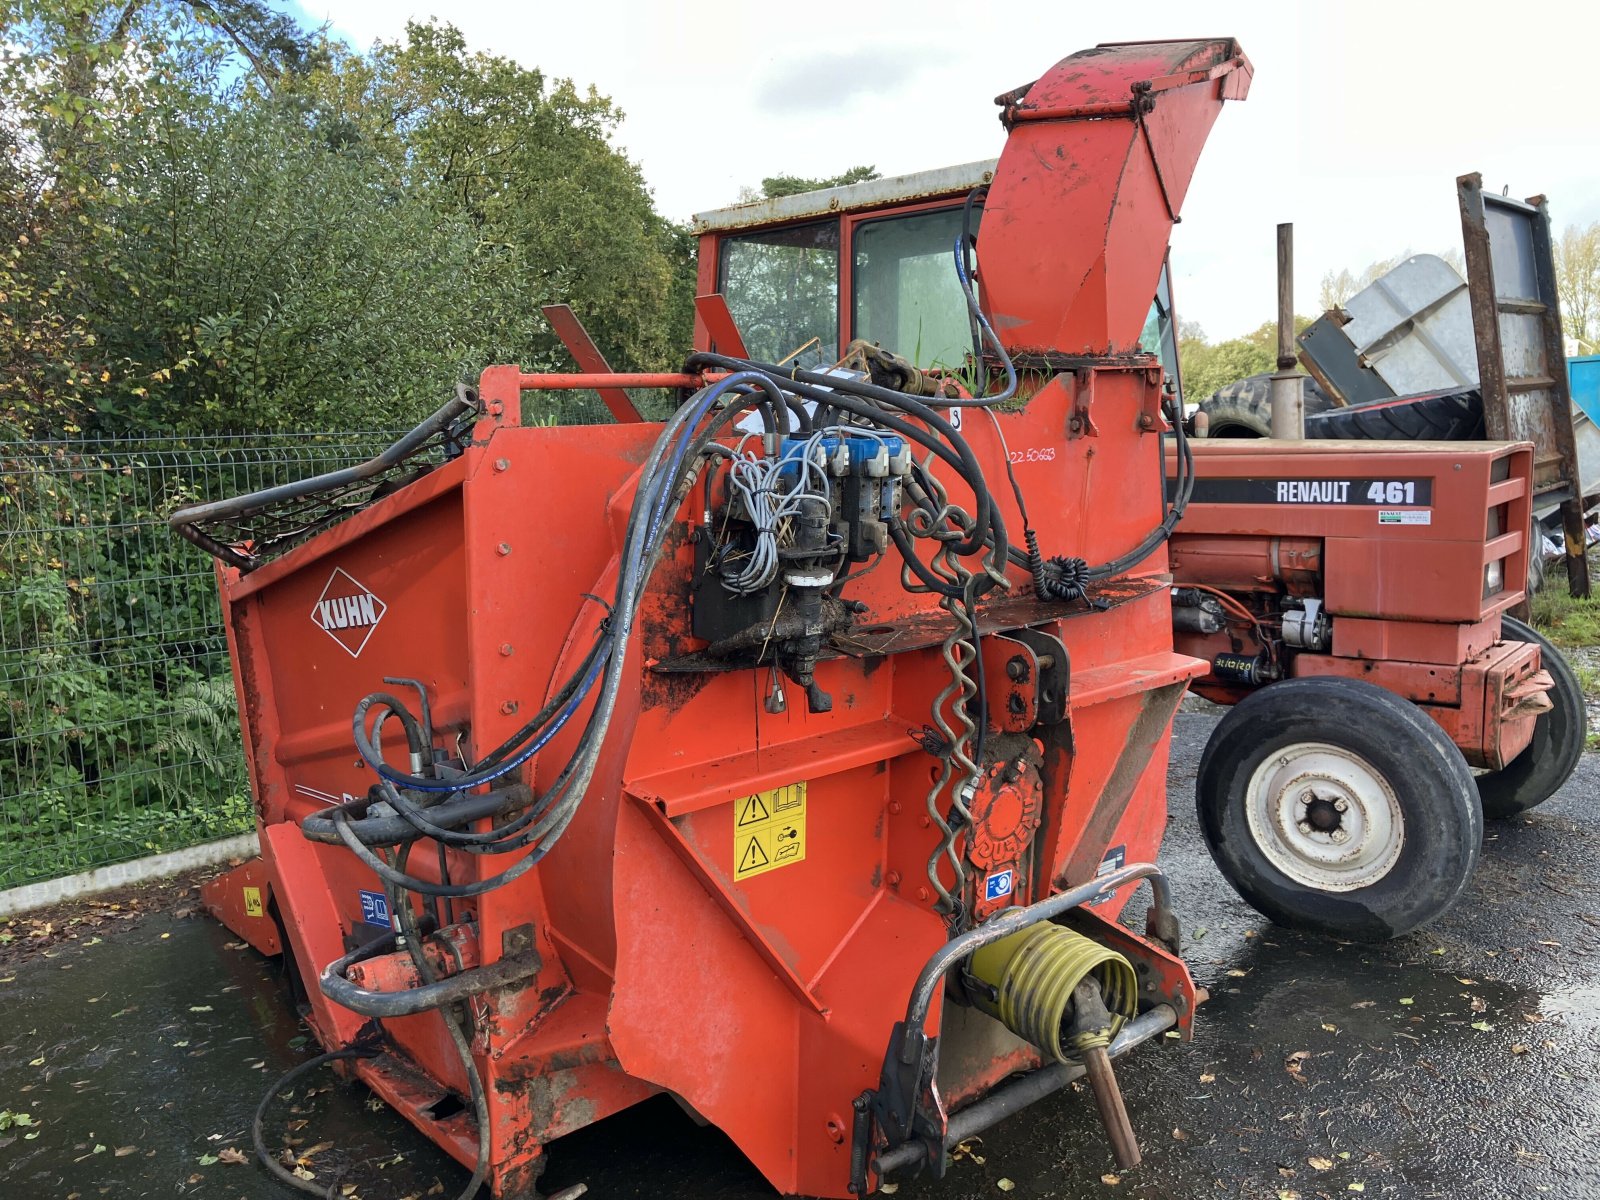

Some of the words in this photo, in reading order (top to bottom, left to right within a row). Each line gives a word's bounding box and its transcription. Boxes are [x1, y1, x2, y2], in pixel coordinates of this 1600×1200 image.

[1277, 481, 1351, 503] RENAULT
[1367, 481, 1416, 504] 461
[319, 593, 377, 630] KUHN
